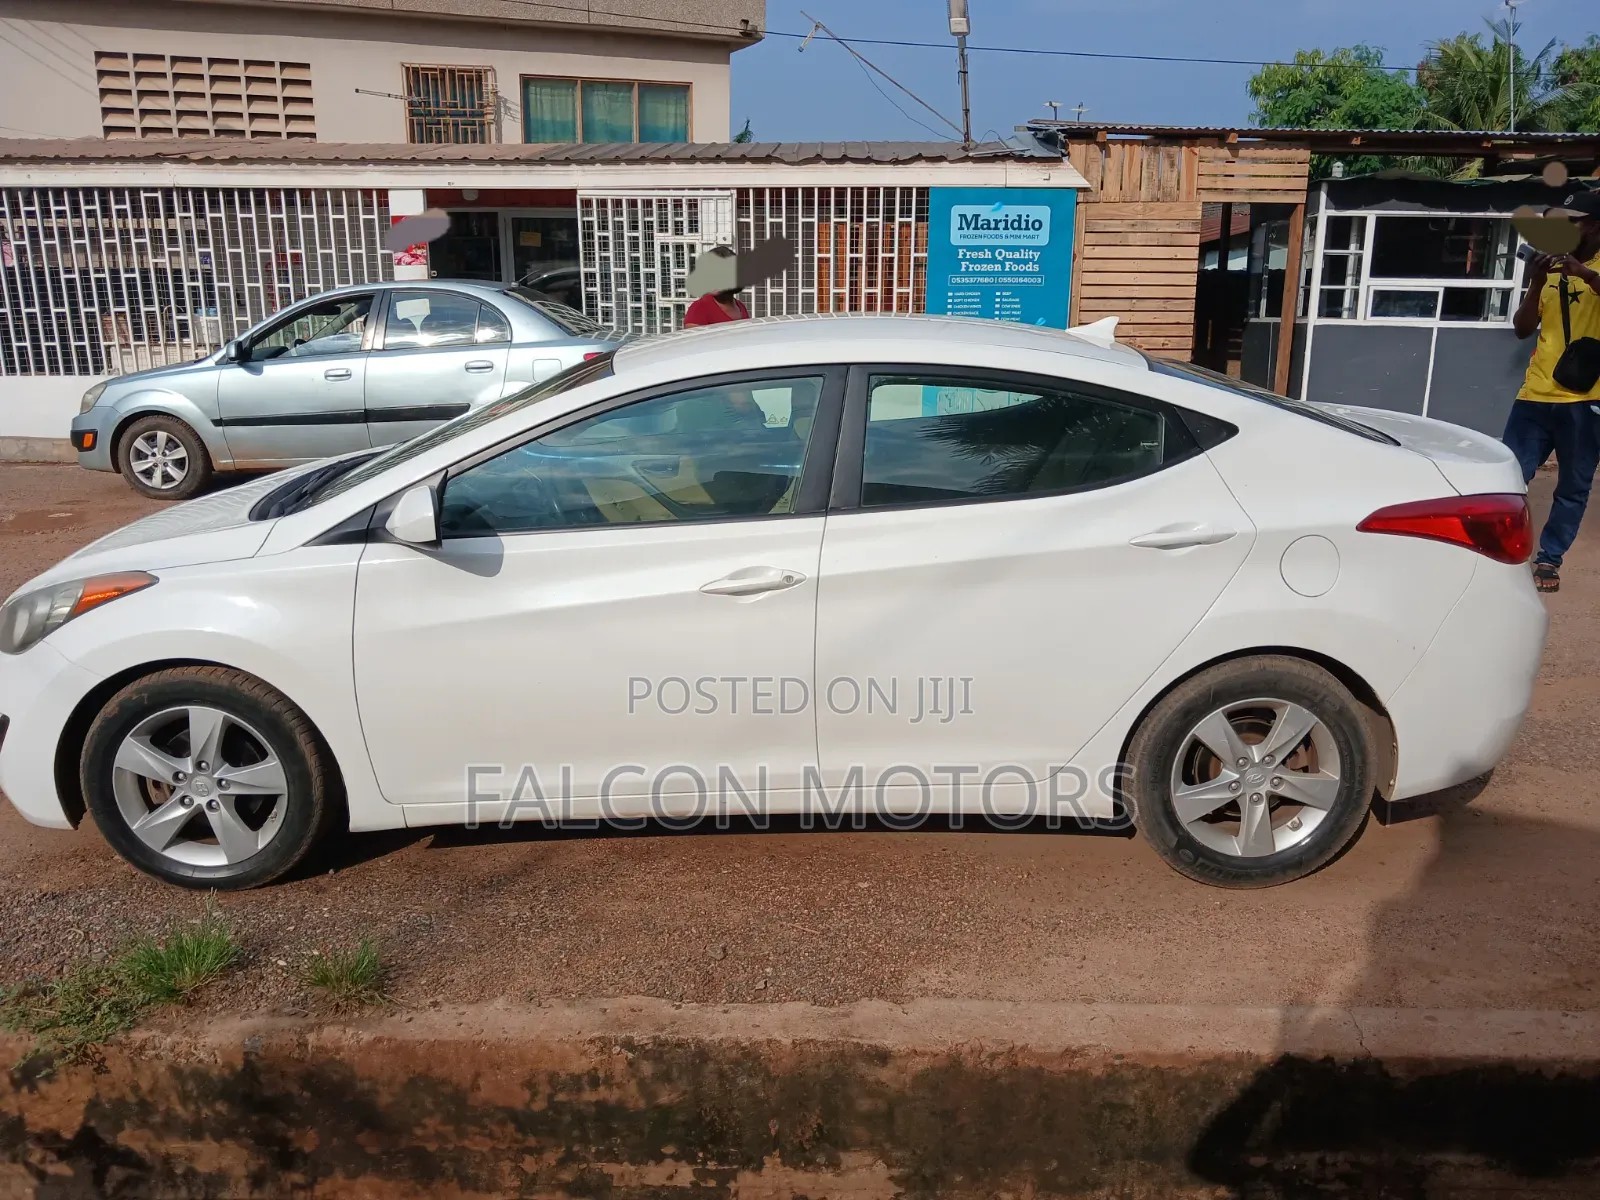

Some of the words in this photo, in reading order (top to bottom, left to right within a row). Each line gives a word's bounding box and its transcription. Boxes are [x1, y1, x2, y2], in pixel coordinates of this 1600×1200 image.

[957, 213, 1043, 232] Maridio
[958, 249, 992, 259] Fresh
[995, 249, 1040, 261] Quality
[960, 262, 1002, 272] Frozen
[1004, 262, 1040, 272] Foods
